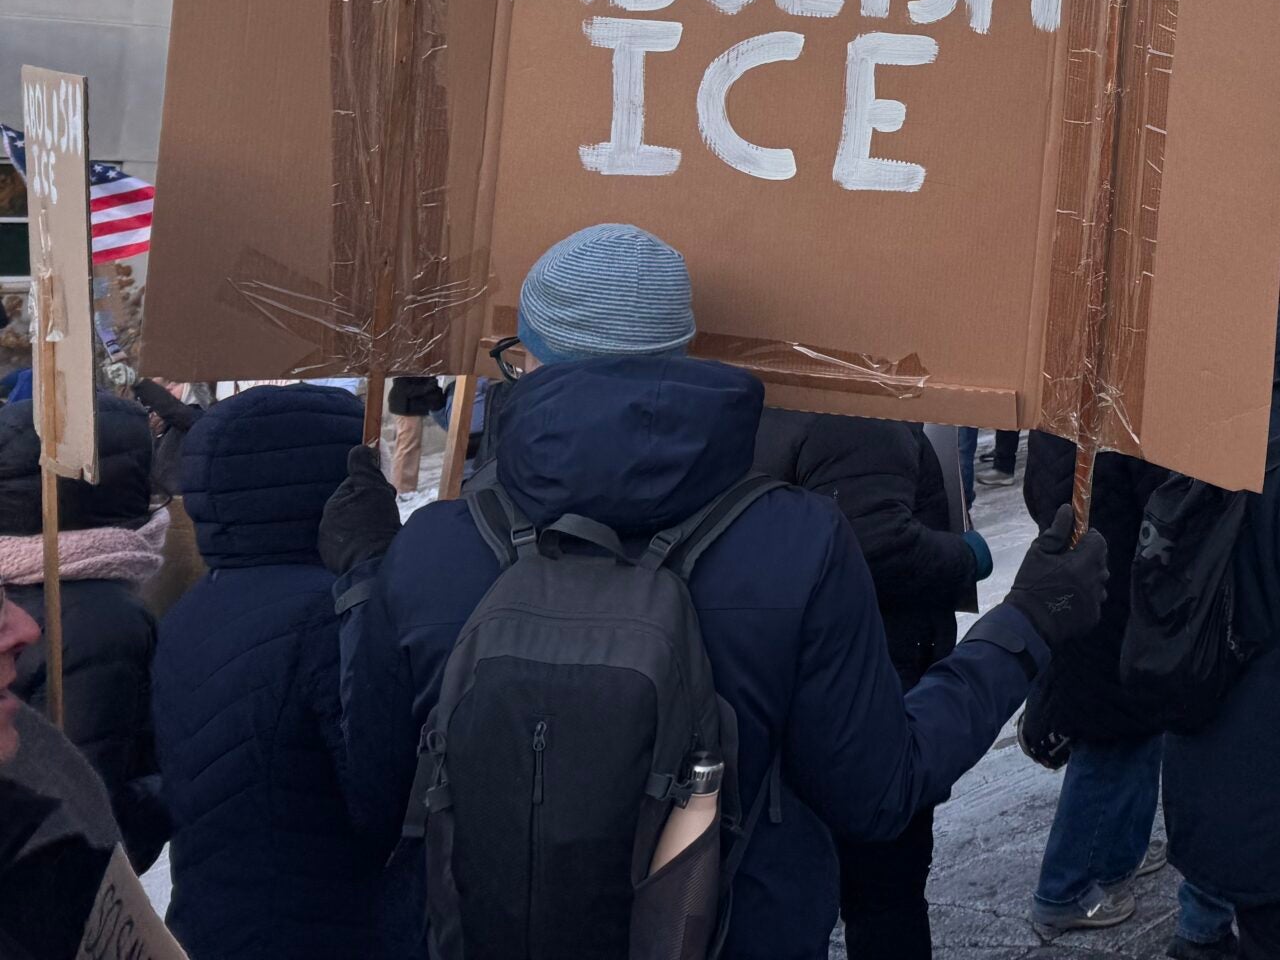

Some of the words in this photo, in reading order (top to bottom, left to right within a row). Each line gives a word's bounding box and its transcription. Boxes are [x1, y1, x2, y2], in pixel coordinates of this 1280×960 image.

[23, 79, 82, 156] ABOLISH
[578, 16, 939, 192] ICE
[32, 144, 58, 205] ICE
